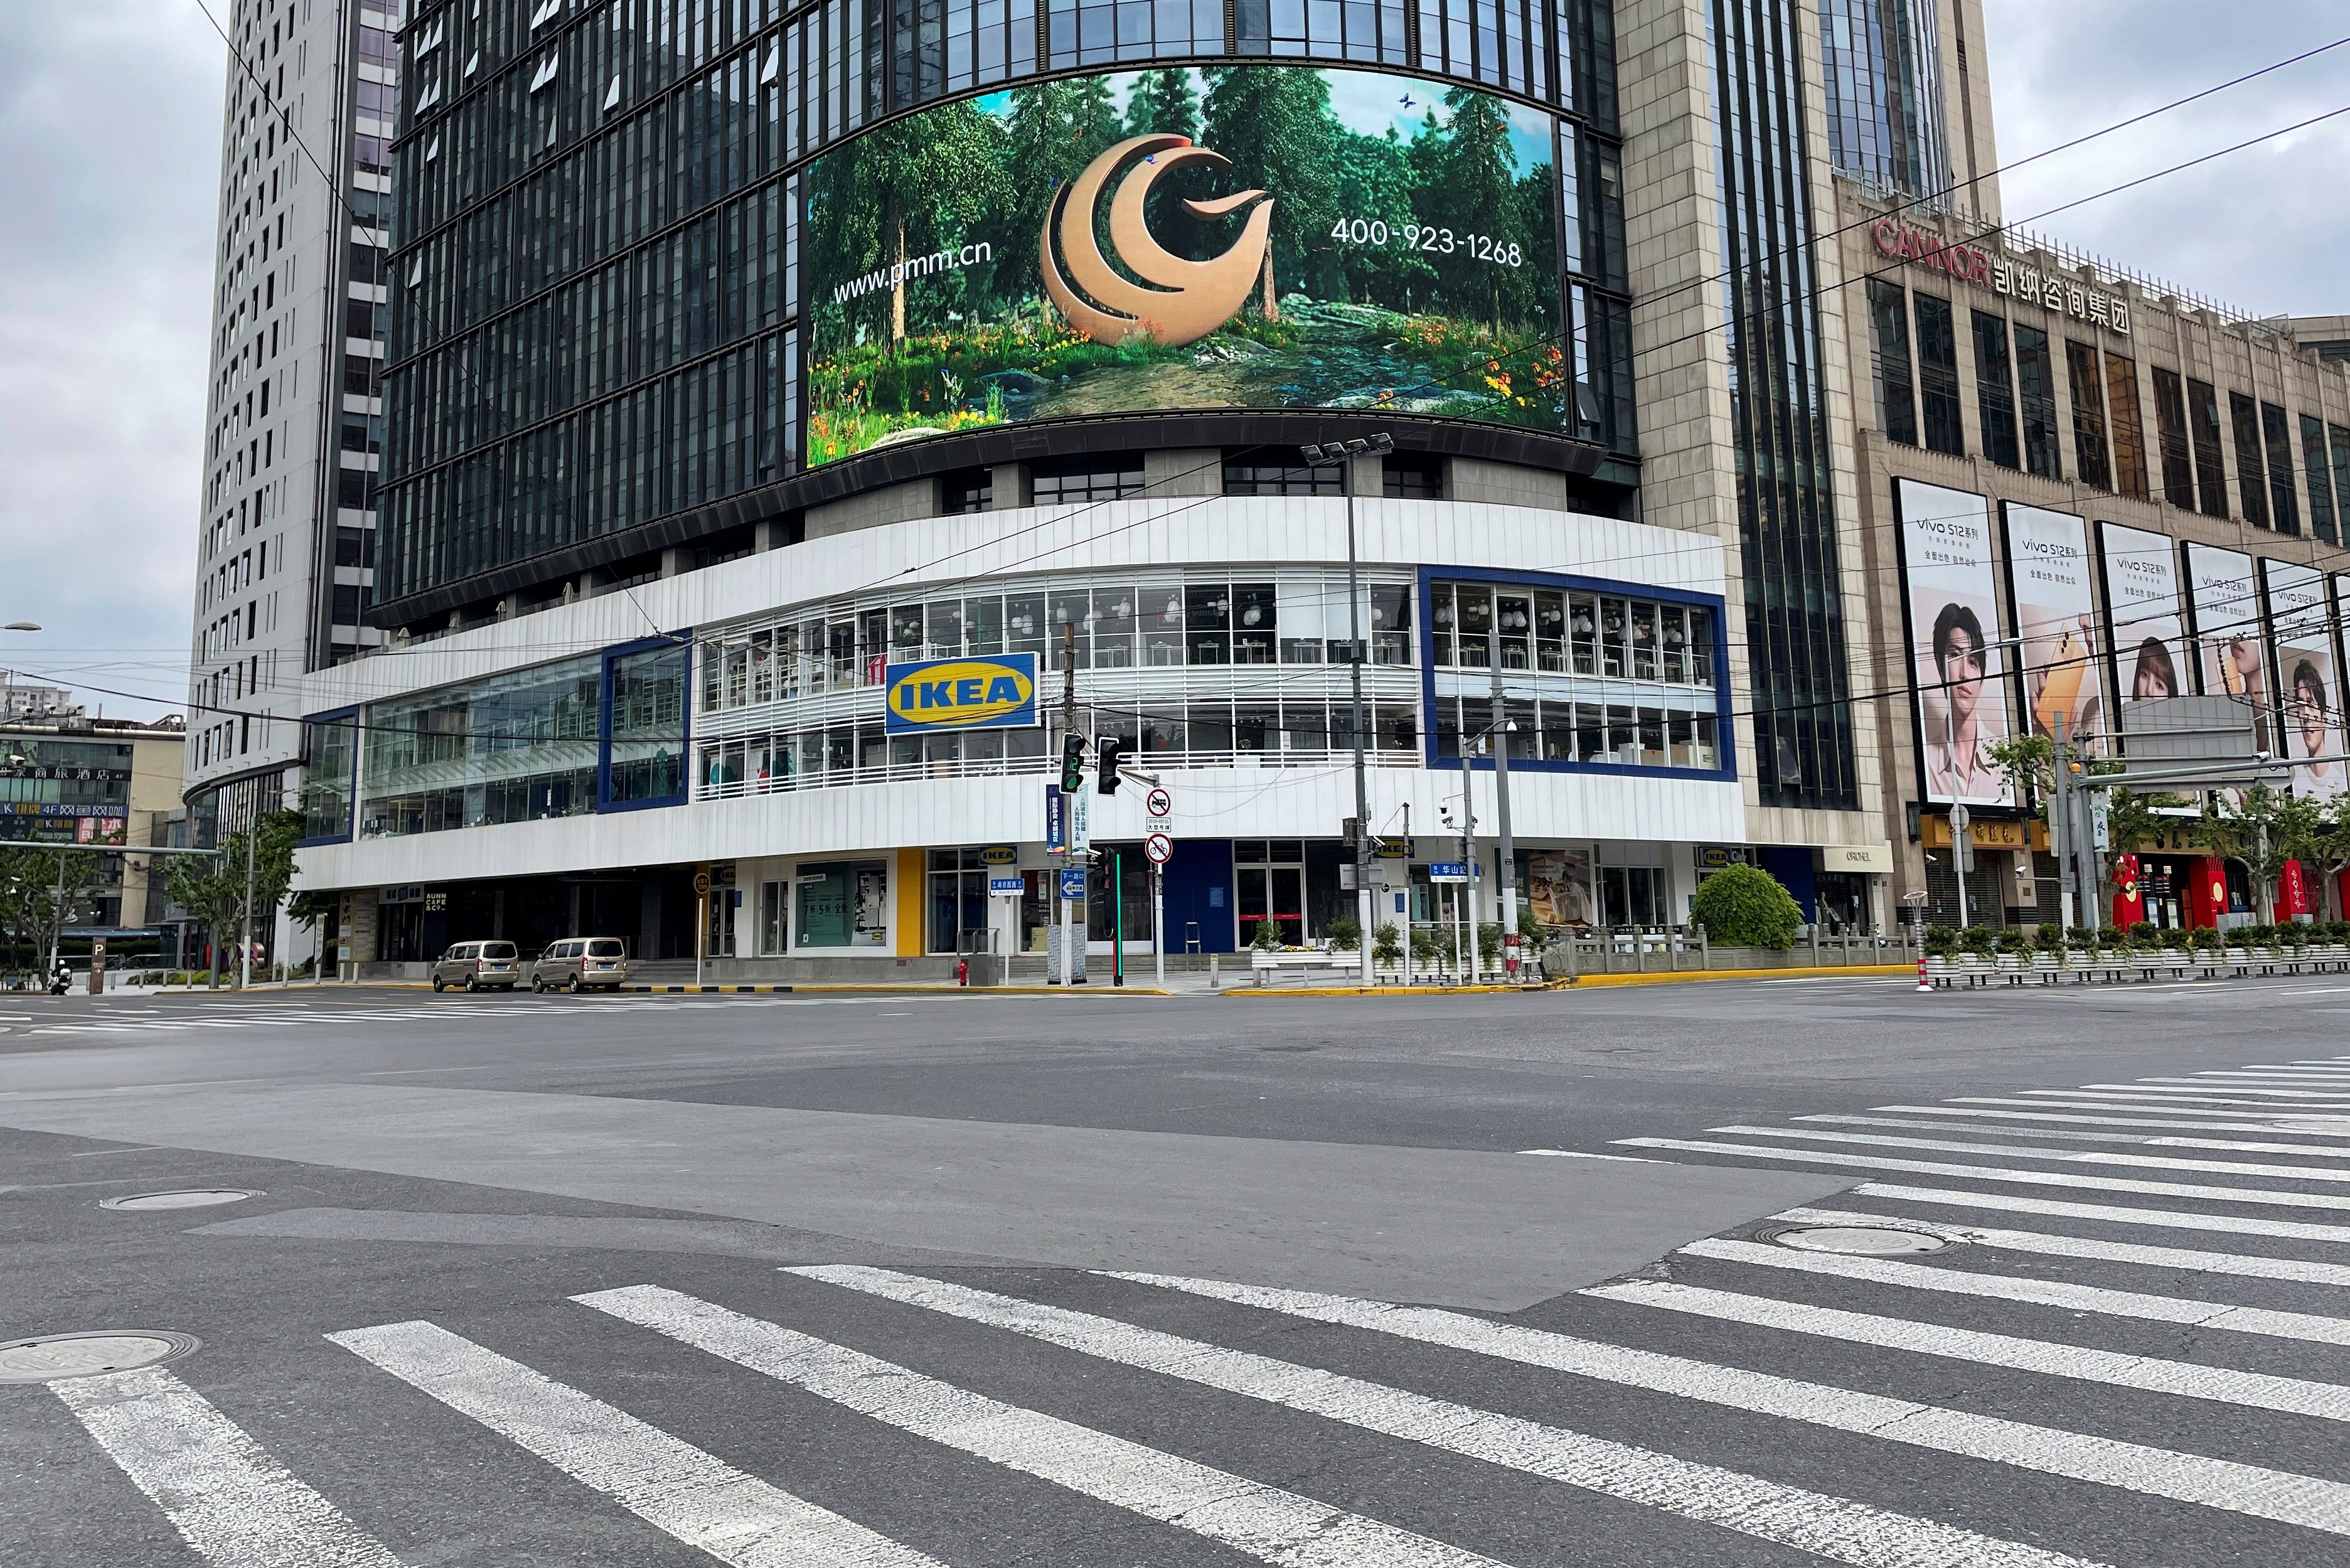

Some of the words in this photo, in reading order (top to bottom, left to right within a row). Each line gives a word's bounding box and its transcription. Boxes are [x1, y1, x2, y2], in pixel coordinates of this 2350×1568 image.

[1330, 217, 1524, 269] 400-923-1268
[1875, 218, 1989, 287] CANNOR
[833, 237, 991, 304] www.pmm.cn
[1992, 258, 2130, 334] 凯纳咨询集团
[1916, 518, 1945, 533] vivo
[1948, 524, 1978, 540] S12系列
[2022, 538, 2048, 553] vivo
[2050, 544, 2078, 558] S12系列
[2117, 557, 2140, 570] vivo
[900, 676, 1022, 710] IKEA
[95, 944, 104, 956] P
